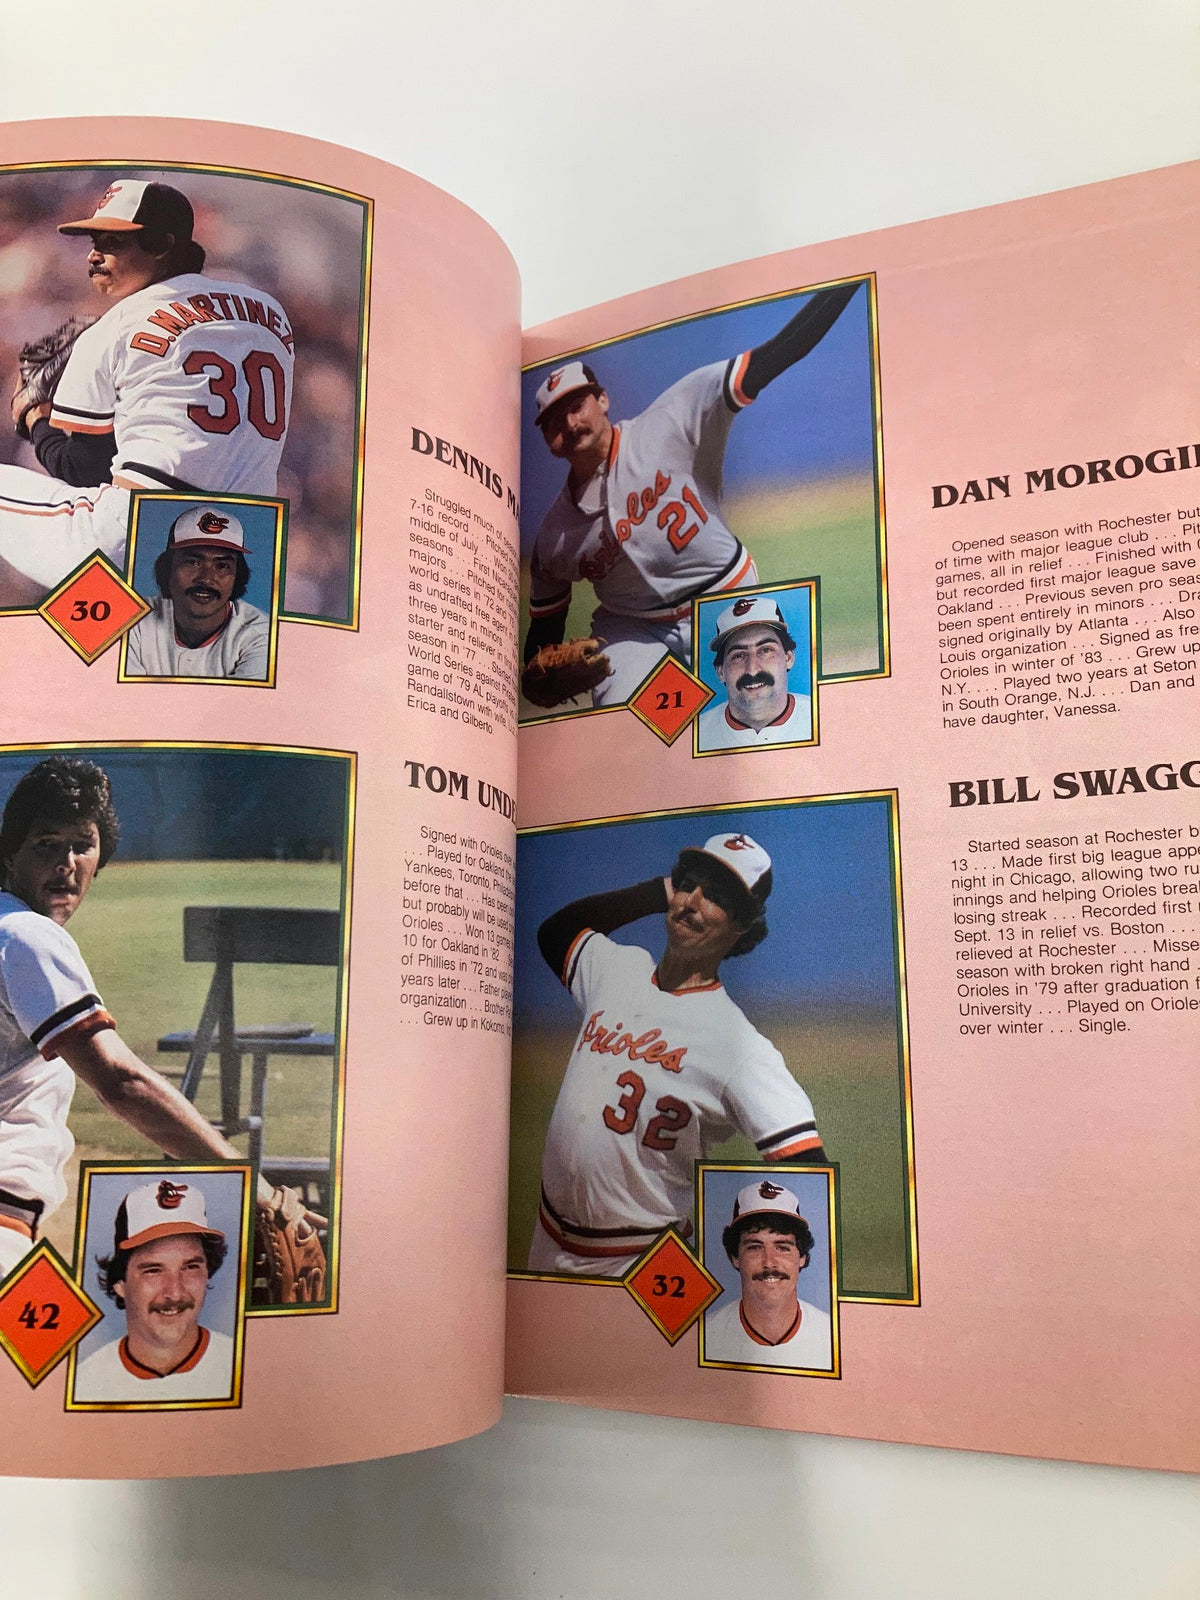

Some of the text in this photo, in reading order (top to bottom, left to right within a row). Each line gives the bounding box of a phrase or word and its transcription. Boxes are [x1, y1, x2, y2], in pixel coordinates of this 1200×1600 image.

[182, 350, 286, 441] 30
[411, 427, 503, 498] DENNIS
[425, 488, 471, 518] Struggled
[931, 475, 1011, 509] DAN
[410, 499, 468, 532] 7-16 record
[410, 516, 446, 537] middle
[657, 483, 708, 555] 21
[952, 512, 1171, 553] Opened season with Rochester
[987, 530, 1148, 563] with major league club
[410, 532, 490, 576] seasons First
[936, 540, 1191, 587] games, relief Finished with
[409, 564, 470, 596] world series
[410, 548, 446, 569] majors
[468, 570, 496, 595] Pitched
[964, 558, 1196, 597] recorded major league save
[70, 600, 111, 622] 30
[408, 596, 468, 626] three years
[426, 586, 472, 612] undrafted
[938, 579, 1163, 616] Oakland Previous seven pro
[408, 613, 466, 640] starter and
[977, 598, 1144, 629] spent entirely minors
[939, 608, 1195, 649] signed originally Atlanta Also
[408, 630, 476, 660] season '77
[940, 628, 1150, 664] Louis organization Signed
[408, 644, 473, 676] World Series
[940, 645, 1176, 680] Orioles winter '83 Grew
[408, 663, 470, 691] game '79
[942, 660, 1196, 696] N.Y. Played years Seton
[408, 678, 492, 718] Randallstown with
[408, 695, 436, 712] Erica
[440, 706, 458, 720] and
[655, 690, 685, 710] 21
[959, 680, 1160, 710] South Orange, N.J. Dan
[943, 703, 1120, 728] have daughter, Vanessa.
[404, 760, 468, 800] TOM
[948, 776, 1040, 807] BILL
[420, 826, 477, 850] Signed with
[968, 827, 1183, 853] Started season Rochester
[428, 844, 461, 864] Played
[952, 848, 1162, 871] 13 Made first big league
[404, 859, 454, 880] Yankees,
[952, 866, 1143, 891] night Chicago, allowing
[404, 878, 440, 894] before
[445, 884, 462, 899] that
[482, 892, 495, 908] Has
[953, 884, 1157, 908] innings helping Orioles
[403, 896, 470, 920] but probably
[954, 900, 1192, 926] losing streak Recorded first
[402, 914, 484, 940] Orioles Won
[954, 922, 1164, 945] Sept. 13 relief vs. Boston
[404, 934, 479, 956] 10 for Oakland
[956, 942, 1116, 961] relieved Rochester
[418, 954, 482, 975] Phillies '72
[956, 957, 1190, 979] season with broken right hand
[401, 974, 460, 989] years later
[957, 977, 1188, 997] Orioles '79 after graduation
[400, 993, 466, 1009] organization
[959, 998, 1119, 1018] University Played
[424, 1011, 454, 1026] Grew
[960, 1018, 1130, 1035] over winter Single.
[602, 1069, 692, 1151] 32
[652, 1274, 686, 1298] 32
[18, 1300, 60, 1330] 42
